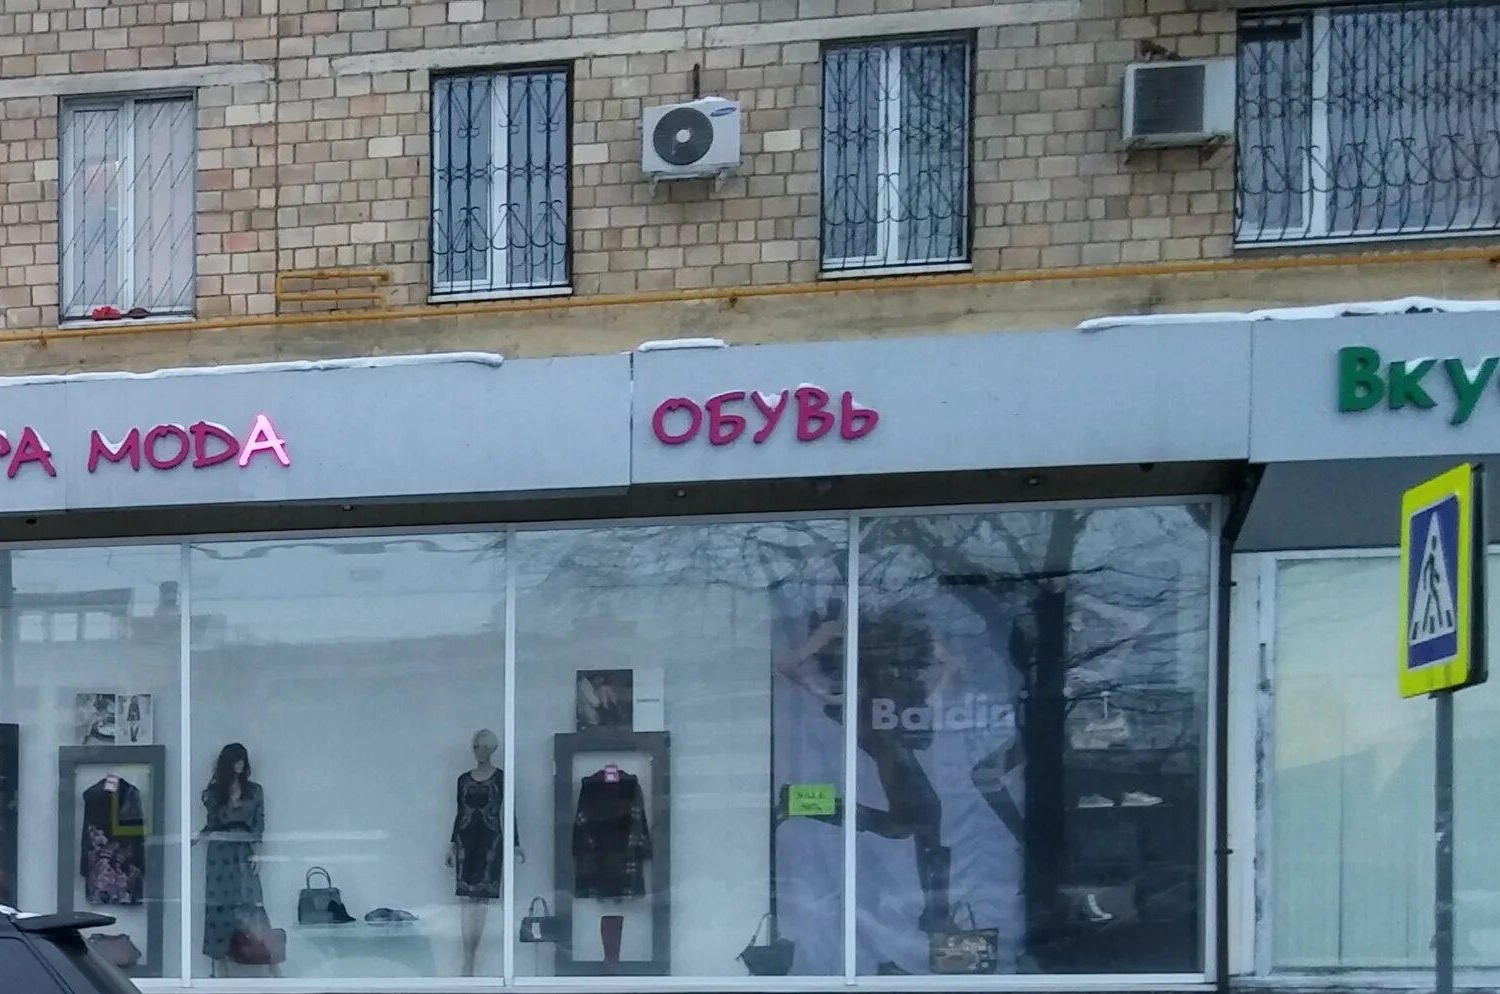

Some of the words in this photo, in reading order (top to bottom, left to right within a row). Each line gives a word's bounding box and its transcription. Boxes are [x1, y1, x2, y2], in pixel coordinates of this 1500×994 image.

[652, 384, 880, 446] ОБУВЬ
[1337, 345, 1500, 426] Вку
[88, 413, 291, 473] МОДА
